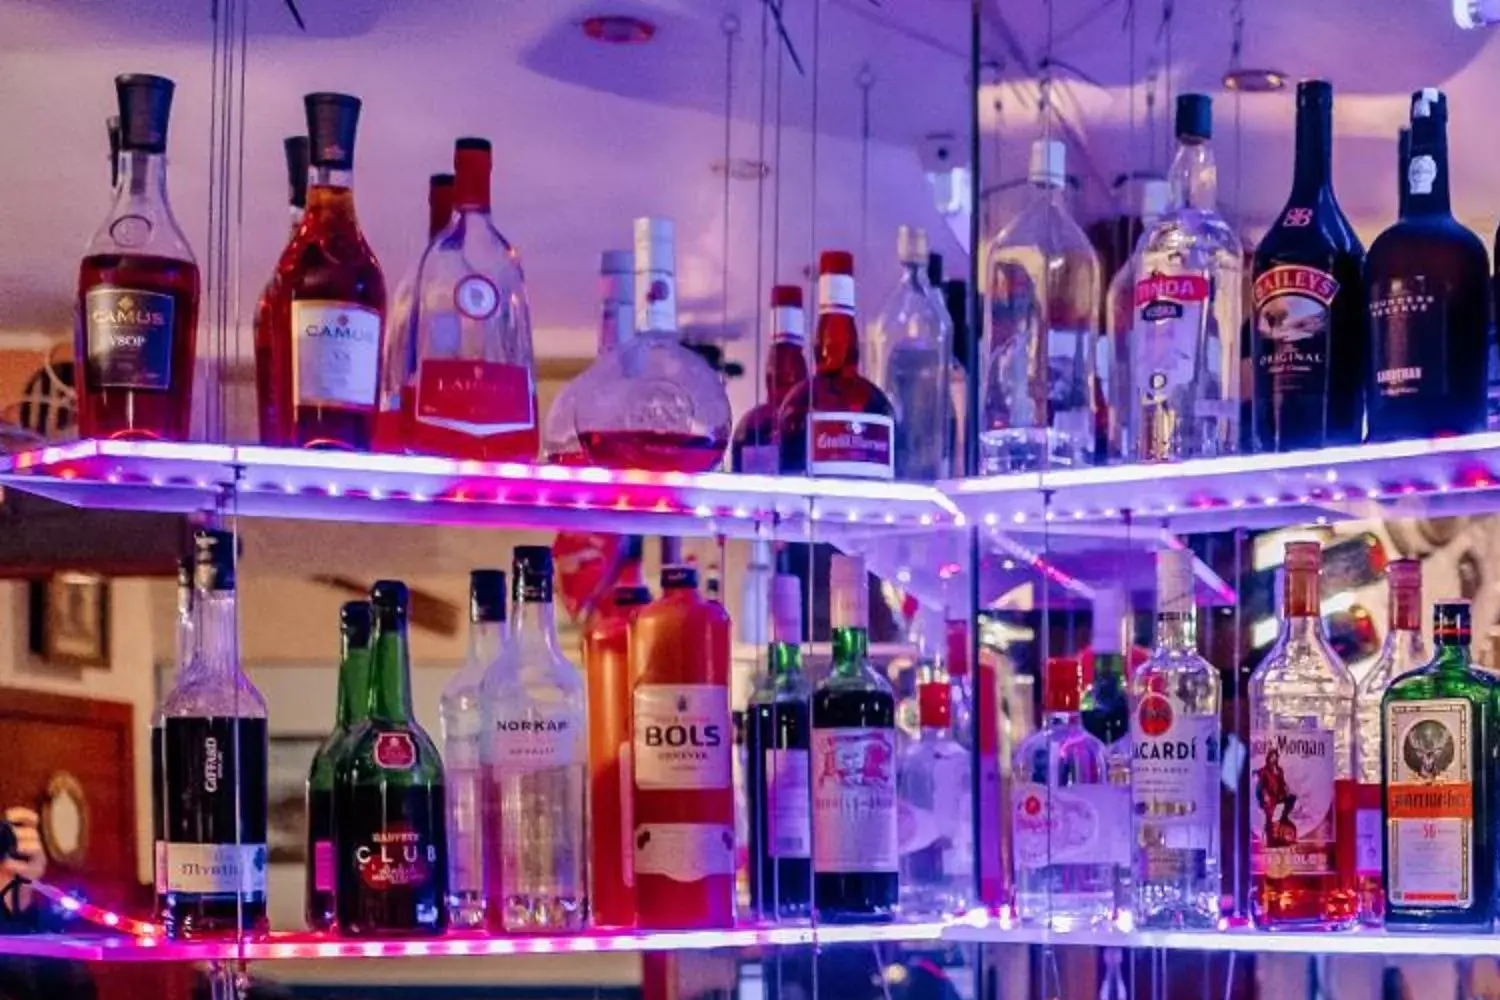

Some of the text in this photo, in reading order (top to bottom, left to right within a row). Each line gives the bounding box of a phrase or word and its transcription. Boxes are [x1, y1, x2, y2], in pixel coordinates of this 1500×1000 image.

[1254, 267, 1334, 299] BAILEYS
[93, 309, 165, 326] CAMUS
[110, 333, 146, 348] VSOP
[645, 724, 722, 748] BOLS
[1277, 734, 1326, 758] Morgan
[355, 845, 437, 864] CLUB
